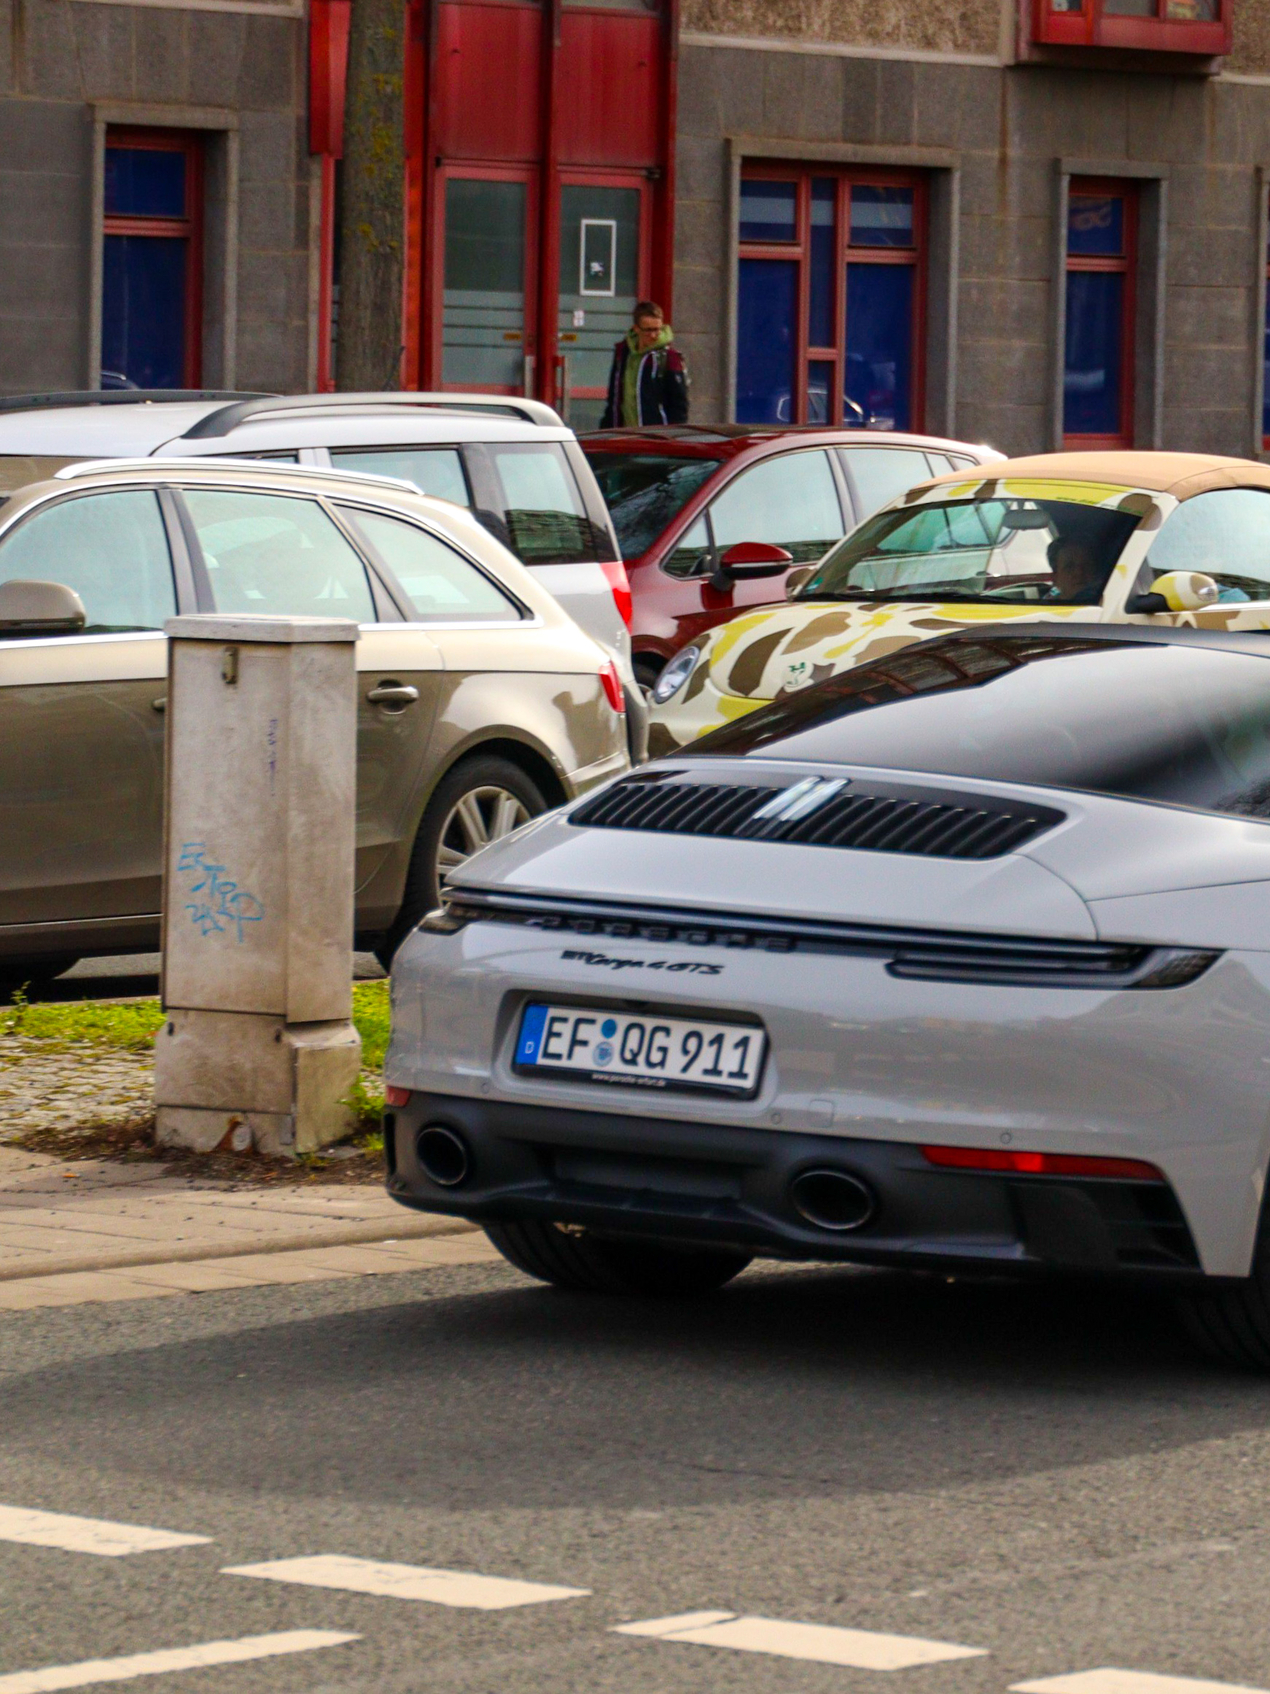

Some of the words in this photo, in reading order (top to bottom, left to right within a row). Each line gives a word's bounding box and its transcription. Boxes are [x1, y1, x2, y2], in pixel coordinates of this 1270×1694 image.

[665, 961, 725, 976] GTS
[541, 1016, 597, 1061] EF
[619, 1022, 671, 1070] QG
[680, 1029, 752, 1081] 911
